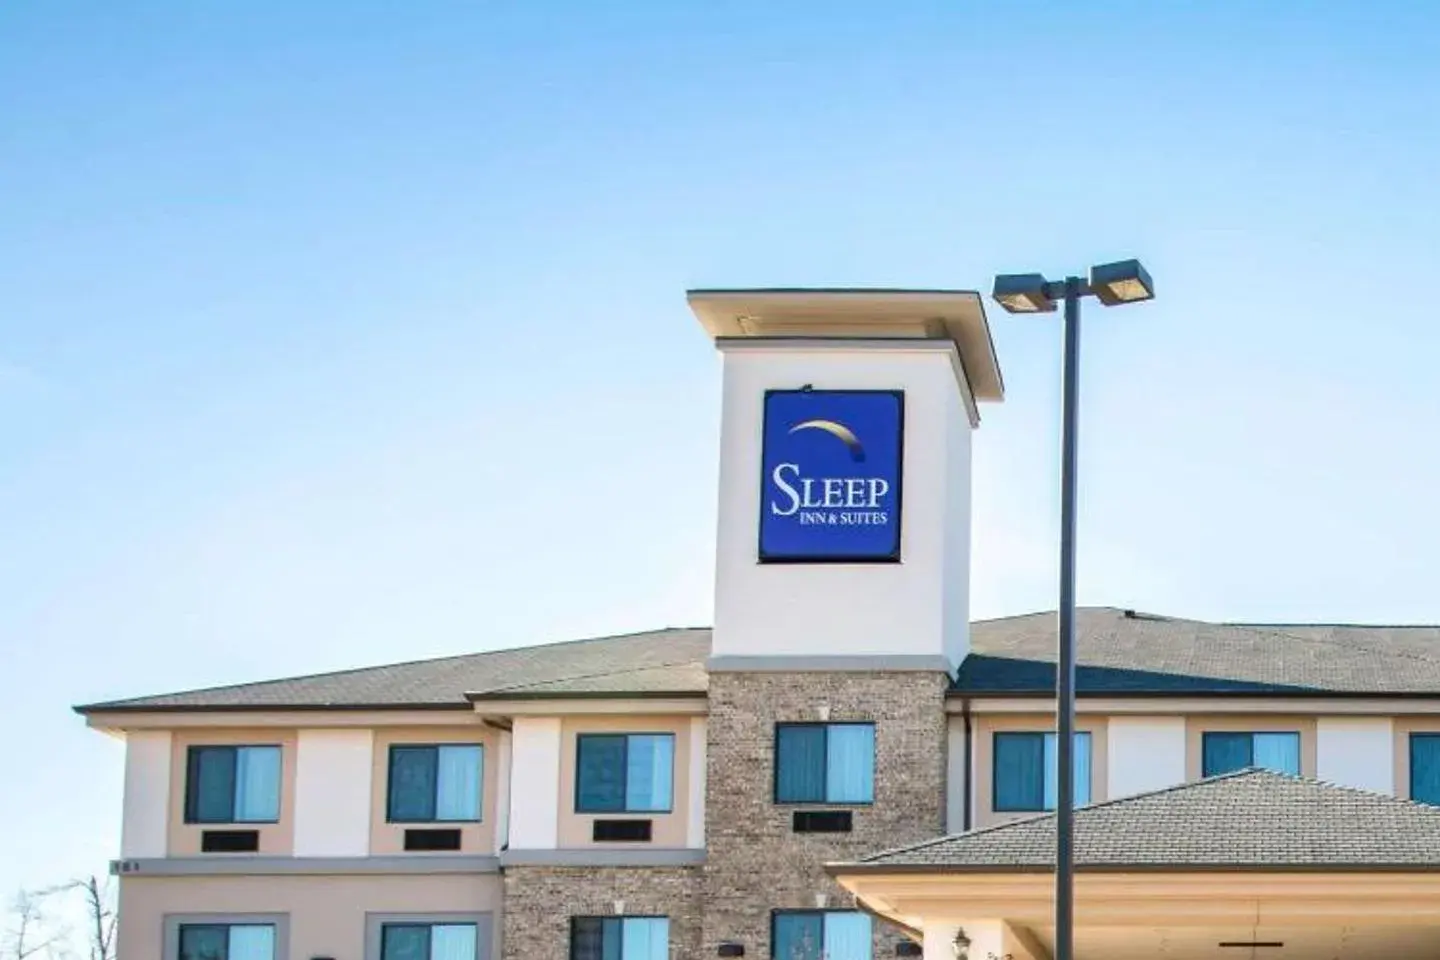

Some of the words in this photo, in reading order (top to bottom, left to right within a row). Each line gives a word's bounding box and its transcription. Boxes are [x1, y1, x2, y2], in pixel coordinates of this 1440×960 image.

[771, 463, 888, 515] SLEEP
[800, 512, 826, 525] INN
[828, 512, 837, 525] &
[840, 512, 888, 525] SUITES
